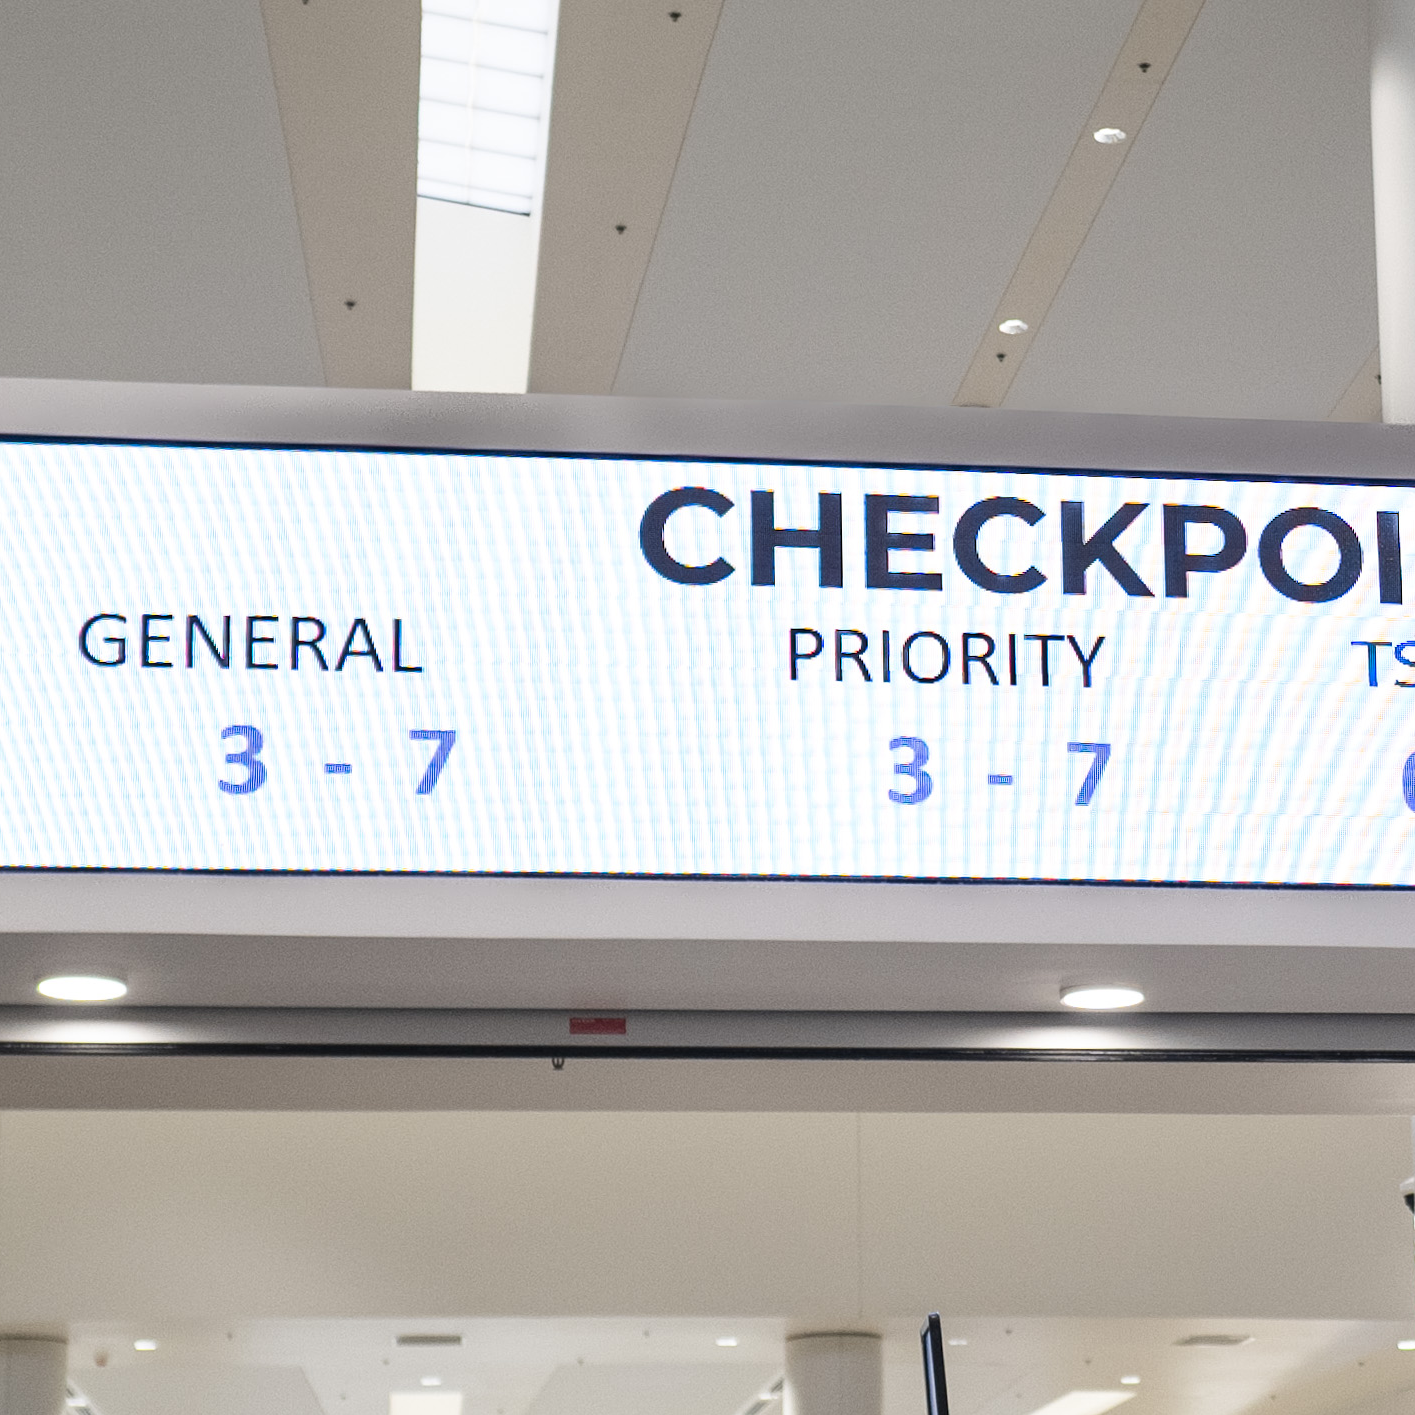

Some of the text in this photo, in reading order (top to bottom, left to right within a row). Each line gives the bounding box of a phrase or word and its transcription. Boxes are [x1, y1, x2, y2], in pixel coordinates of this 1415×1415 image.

[78, 612, 425, 674] GENERAL
[786, 627, 1108, 690] PRIORITY
[217, 723, 269, 796] 3
[407, 728, 458, 796] 7
[886, 736, 935, 806] 3
[1065, 741, 1113, 808] 7
